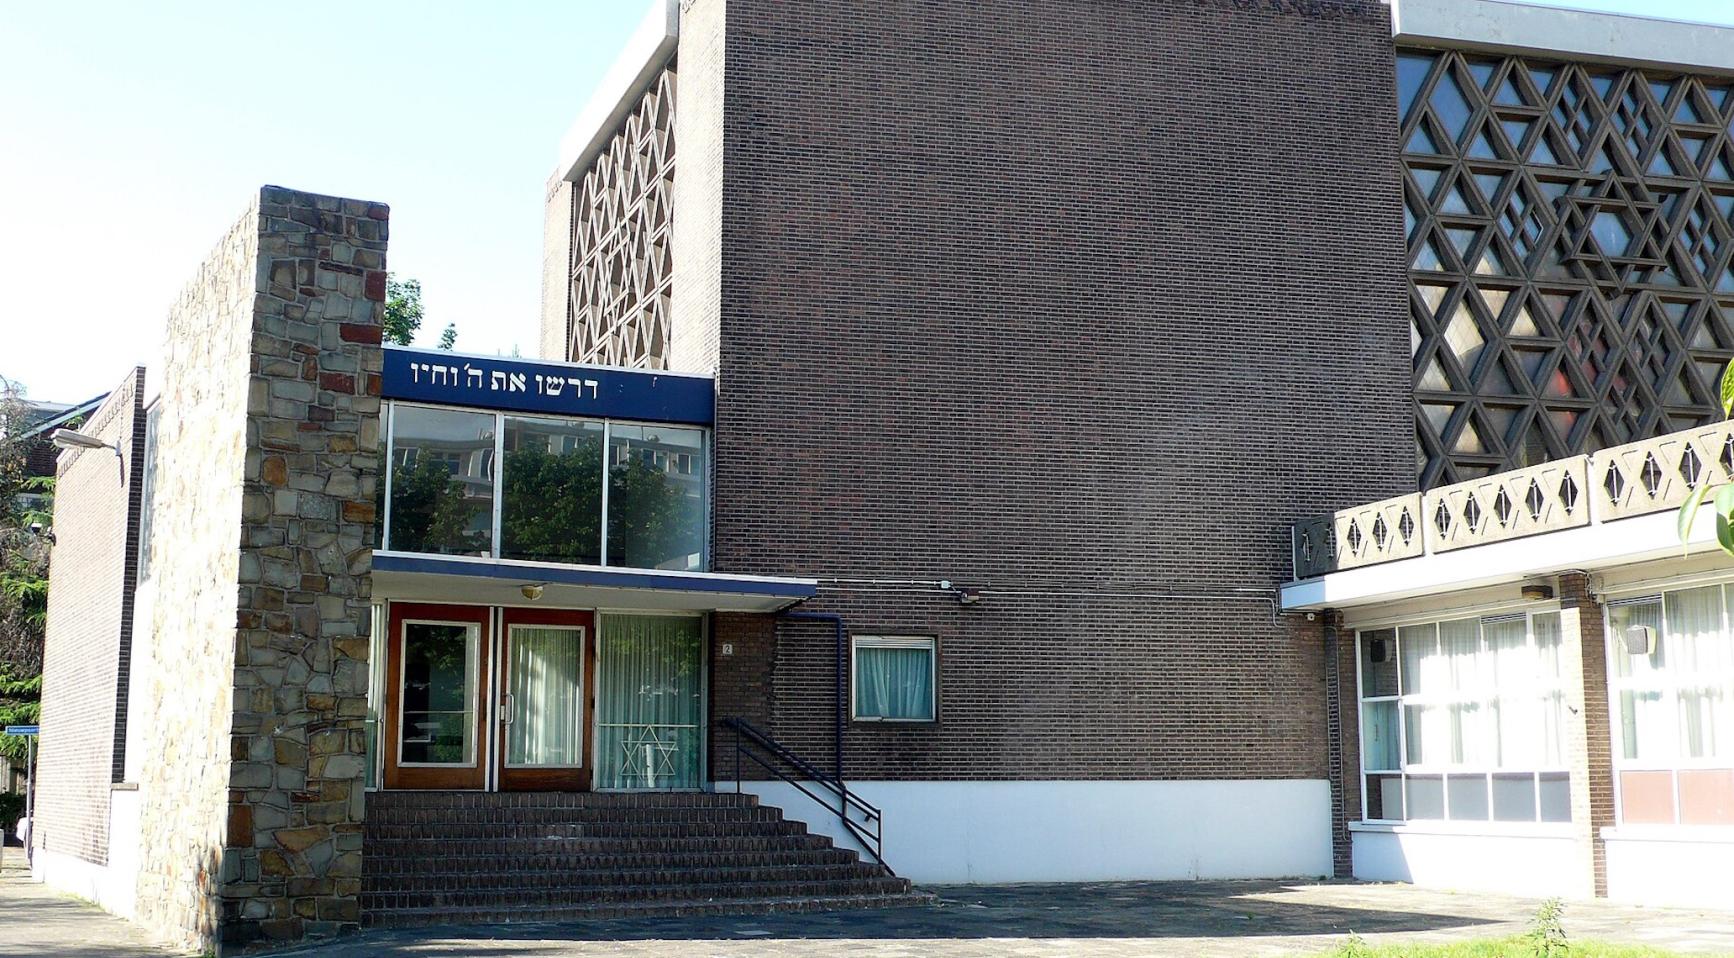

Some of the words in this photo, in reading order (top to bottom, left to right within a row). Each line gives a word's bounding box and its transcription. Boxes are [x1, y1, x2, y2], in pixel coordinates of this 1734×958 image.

[410, 362, 459, 387] וחיו
[491, 370, 527, 393] את
[535, 374, 599, 400] דרשו
